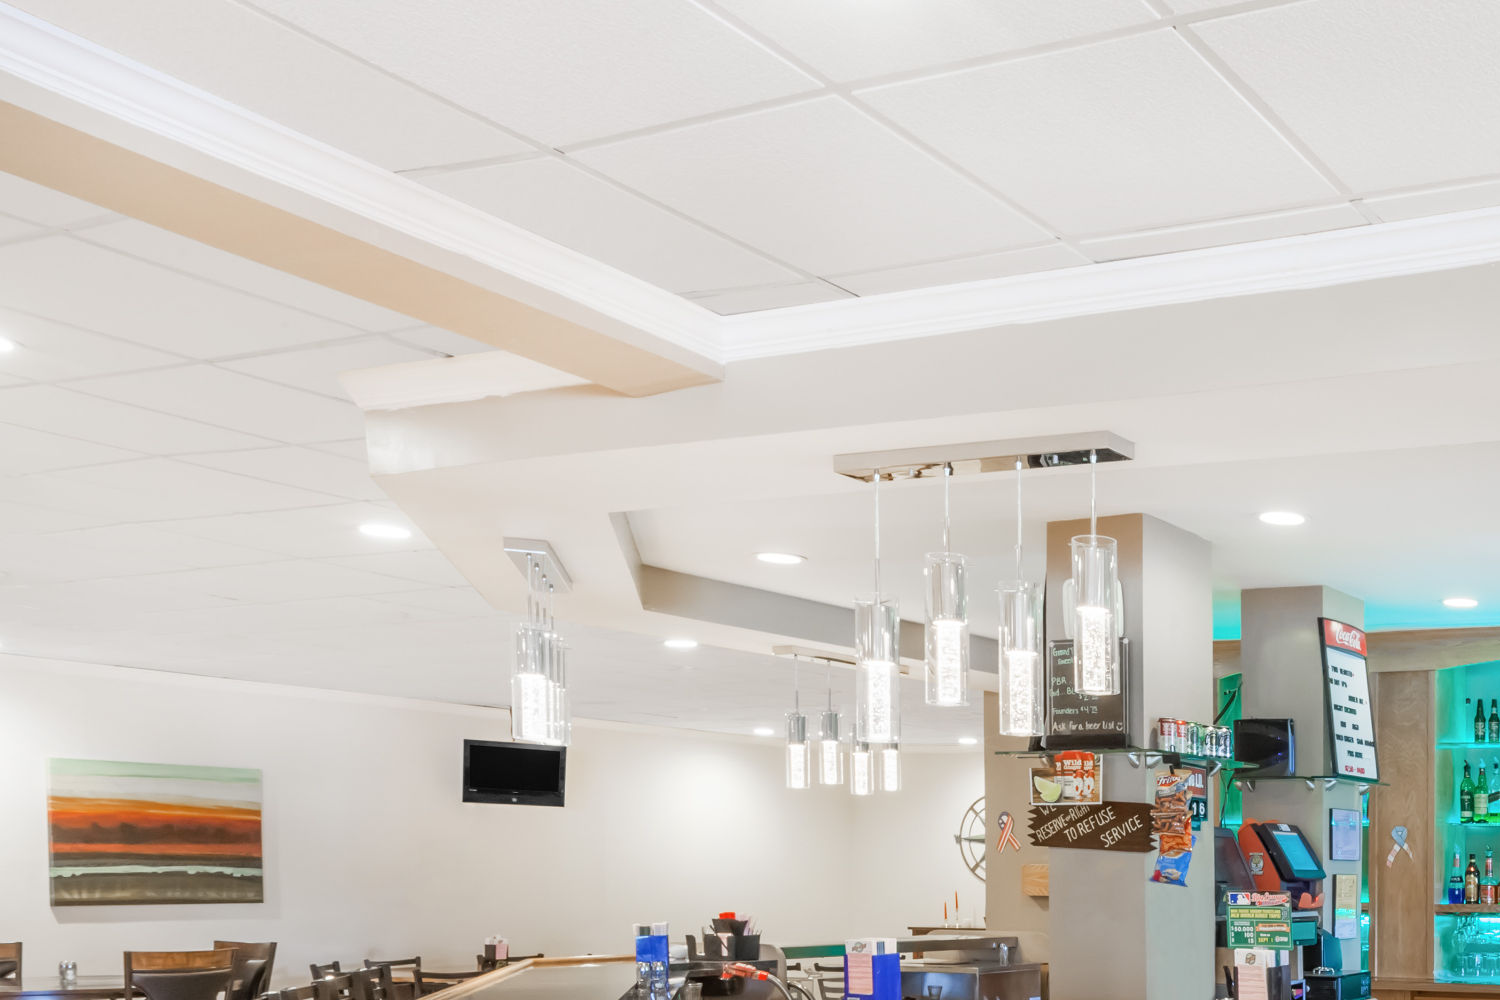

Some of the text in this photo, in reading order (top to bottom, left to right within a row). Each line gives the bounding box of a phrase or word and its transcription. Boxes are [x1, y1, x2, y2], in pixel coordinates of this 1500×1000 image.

[1035, 813, 1068, 842] RESERVE
[1063, 806, 1116, 842] TO REFUSE
[1100, 814, 1144, 848] SERVICE
